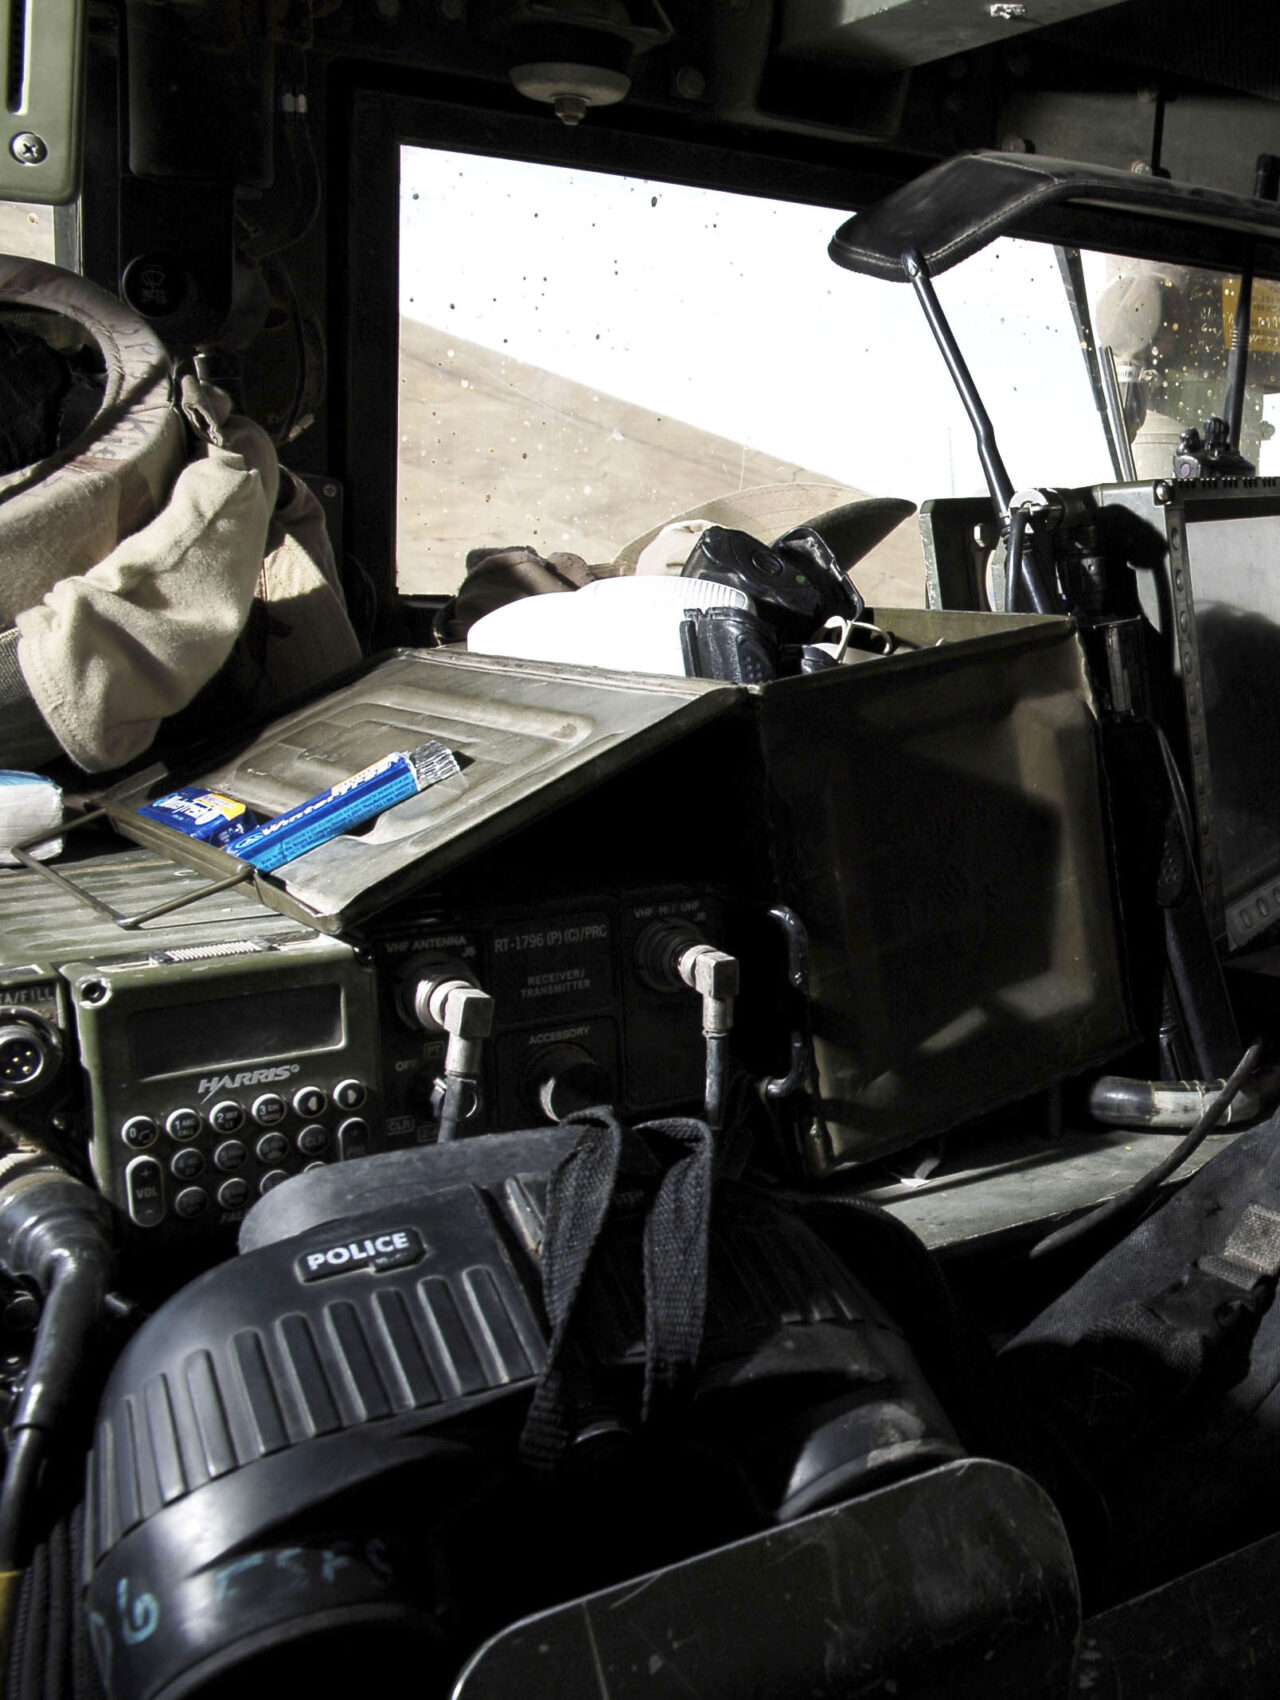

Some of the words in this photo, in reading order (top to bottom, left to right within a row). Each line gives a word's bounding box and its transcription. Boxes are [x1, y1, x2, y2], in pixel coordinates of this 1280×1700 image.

[385, 940, 409, 953] VHF
[412, 935, 468, 951] ANTENNA
[493, 932, 545, 954] RT-1796
[527, 968, 586, 987] RECEIVER/
[520, 978, 592, 999] TRANSMITTER
[528, 1025, 592, 1046] ACCESSORY
[136, 1188, 159, 1200] VOL
[306, 1232, 410, 1271] POLICE
